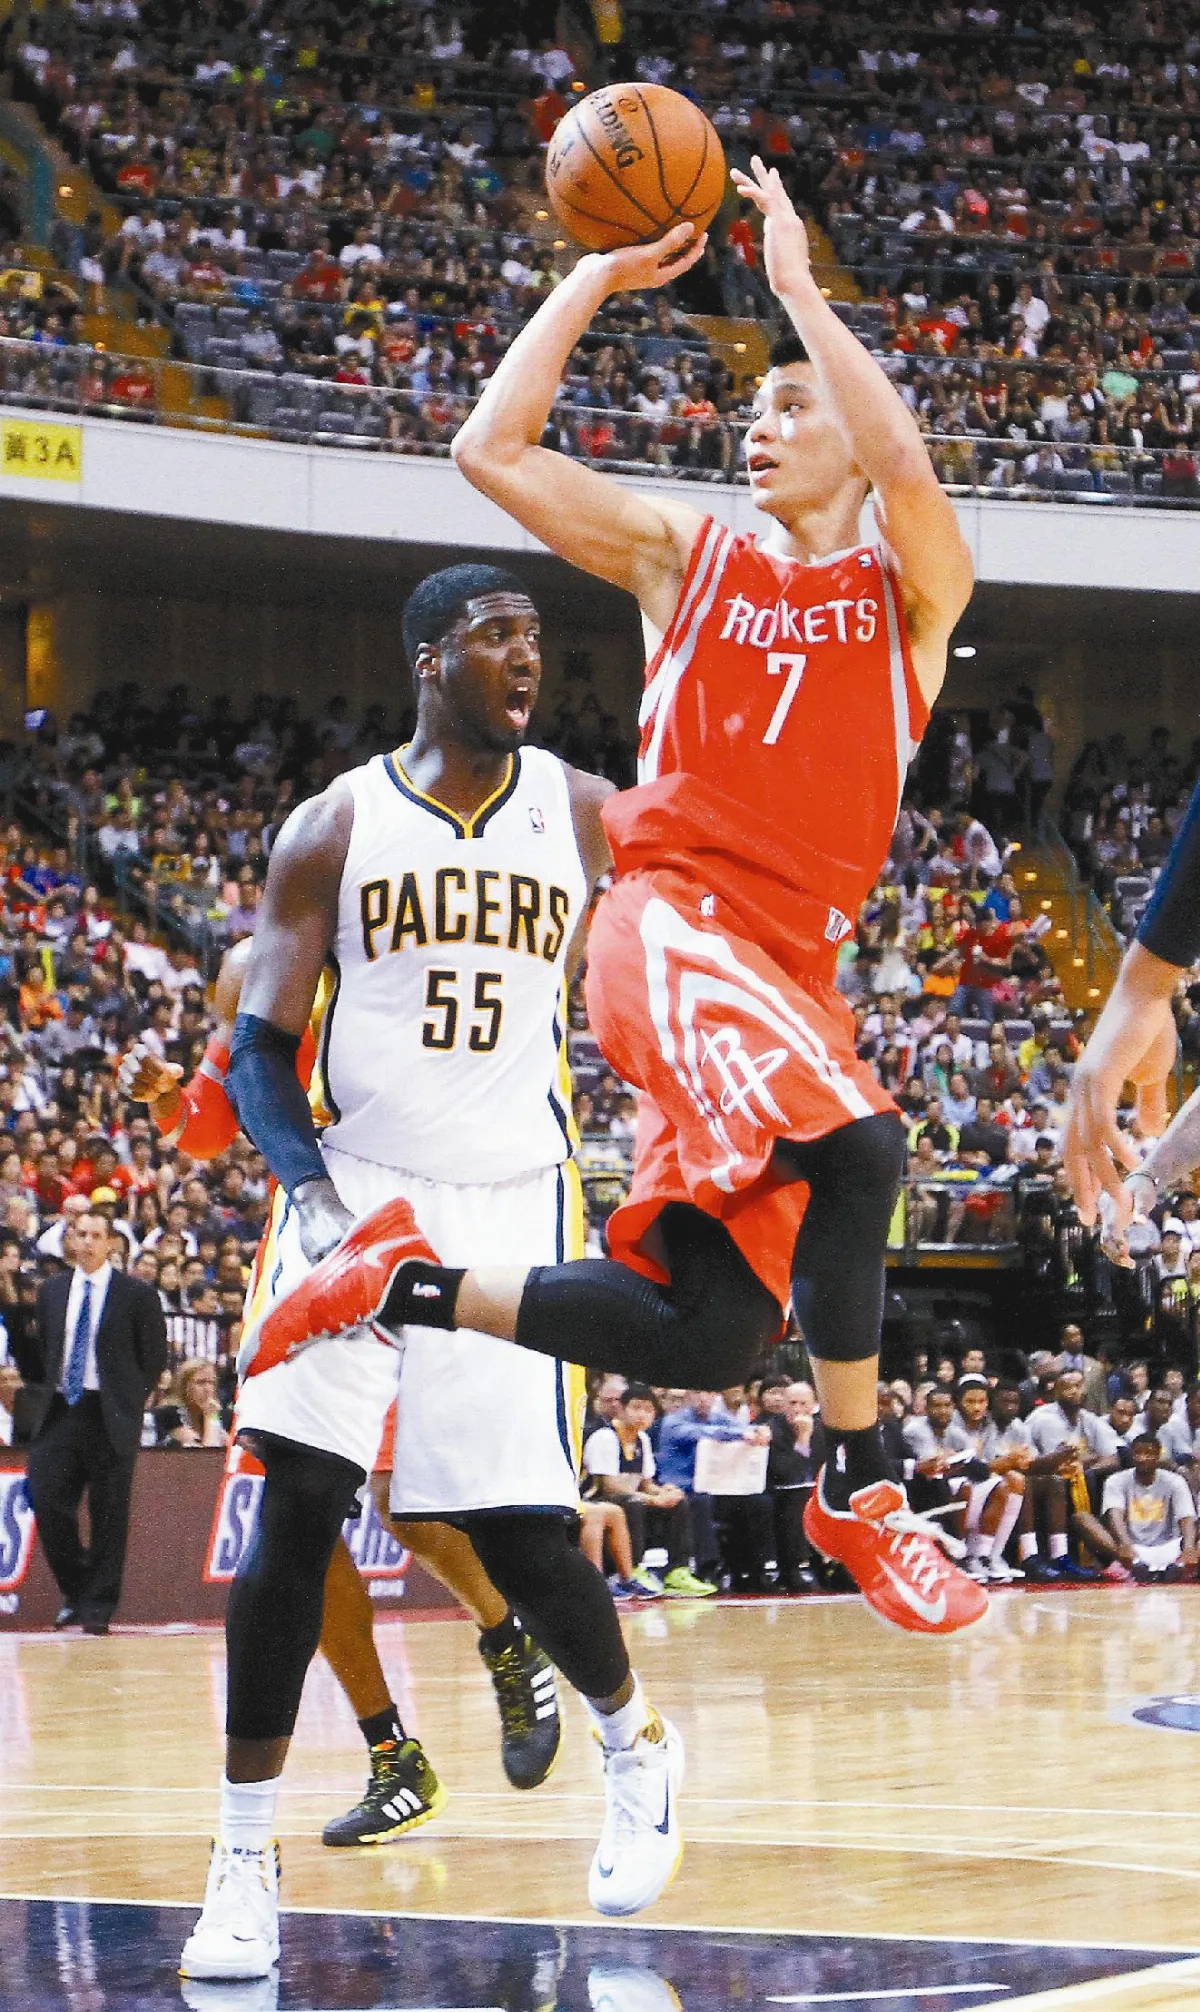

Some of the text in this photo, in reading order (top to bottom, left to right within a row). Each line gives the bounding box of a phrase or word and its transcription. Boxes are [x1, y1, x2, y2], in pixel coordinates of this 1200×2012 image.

[719, 592, 878, 648] ROKETS
[762, 651, 808, 745] 7
[360, 866, 570, 962] PACERS
[421, 969, 503, 1052] 55
